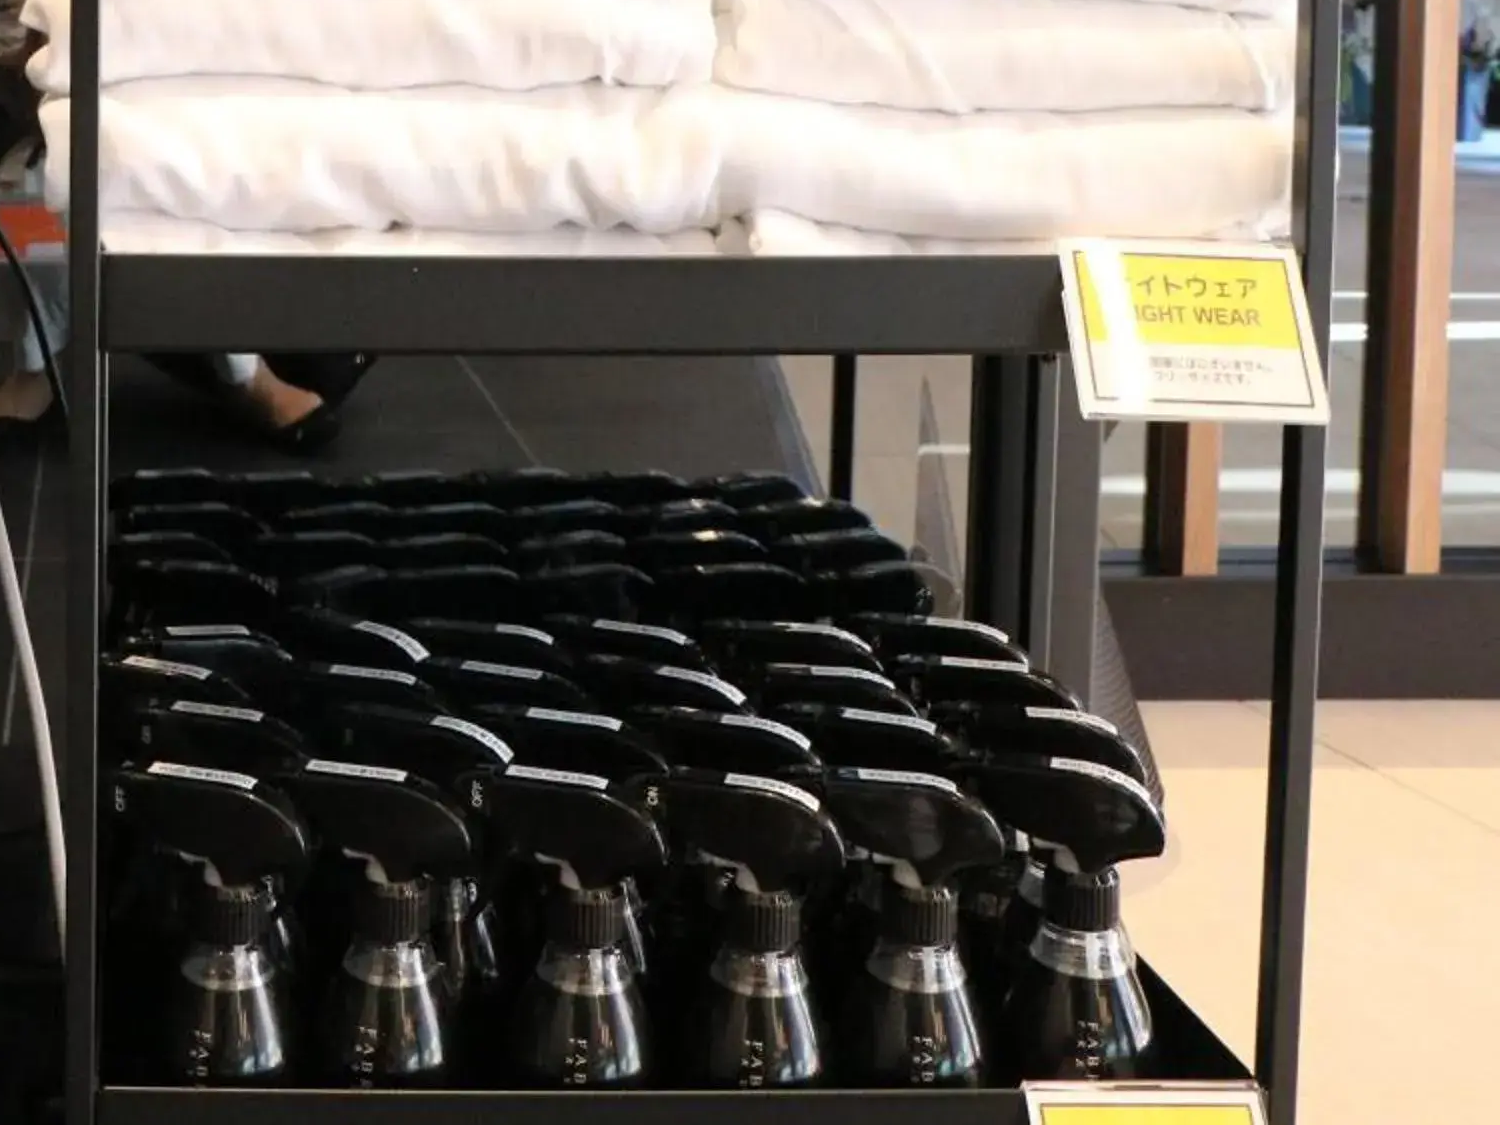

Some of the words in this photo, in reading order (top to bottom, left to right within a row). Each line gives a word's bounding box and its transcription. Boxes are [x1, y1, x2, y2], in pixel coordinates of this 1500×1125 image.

[1126, 274, 1258, 299] イトウェア
[1133, 304, 1187, 324] IGHT
[1192, 306, 1263, 327] WEAR
